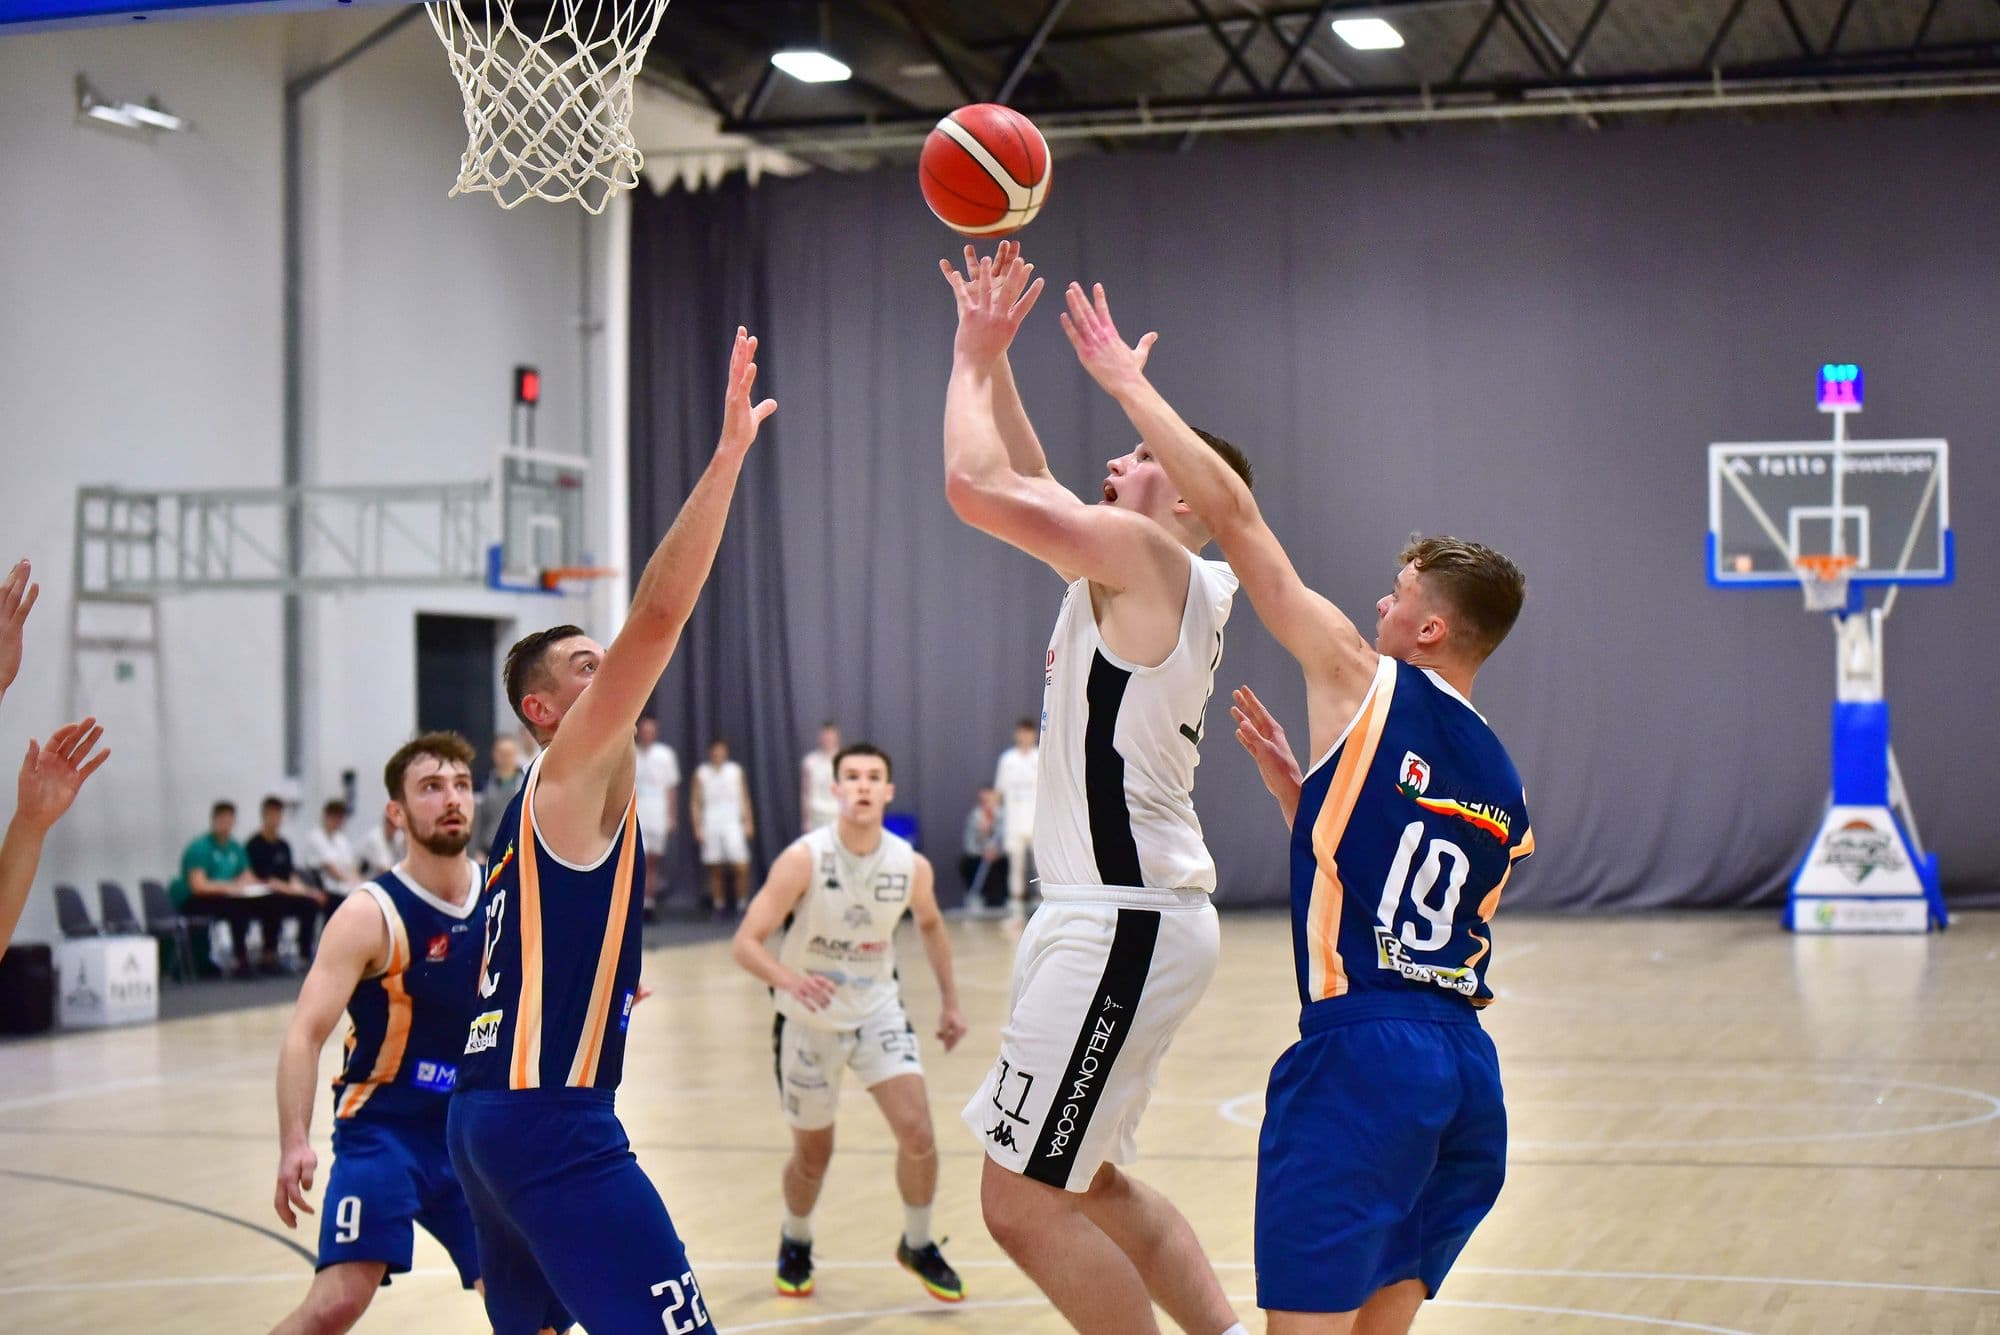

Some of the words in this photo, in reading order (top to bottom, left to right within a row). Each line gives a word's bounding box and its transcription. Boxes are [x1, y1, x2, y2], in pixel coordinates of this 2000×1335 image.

[873, 873, 908, 902] 23
[1376, 820, 1471, 952] 19
[1068, 1016, 1116, 1100] ZIELONA
[335, 1196, 362, 1244] 9
[650, 1270, 708, 1335] 22
